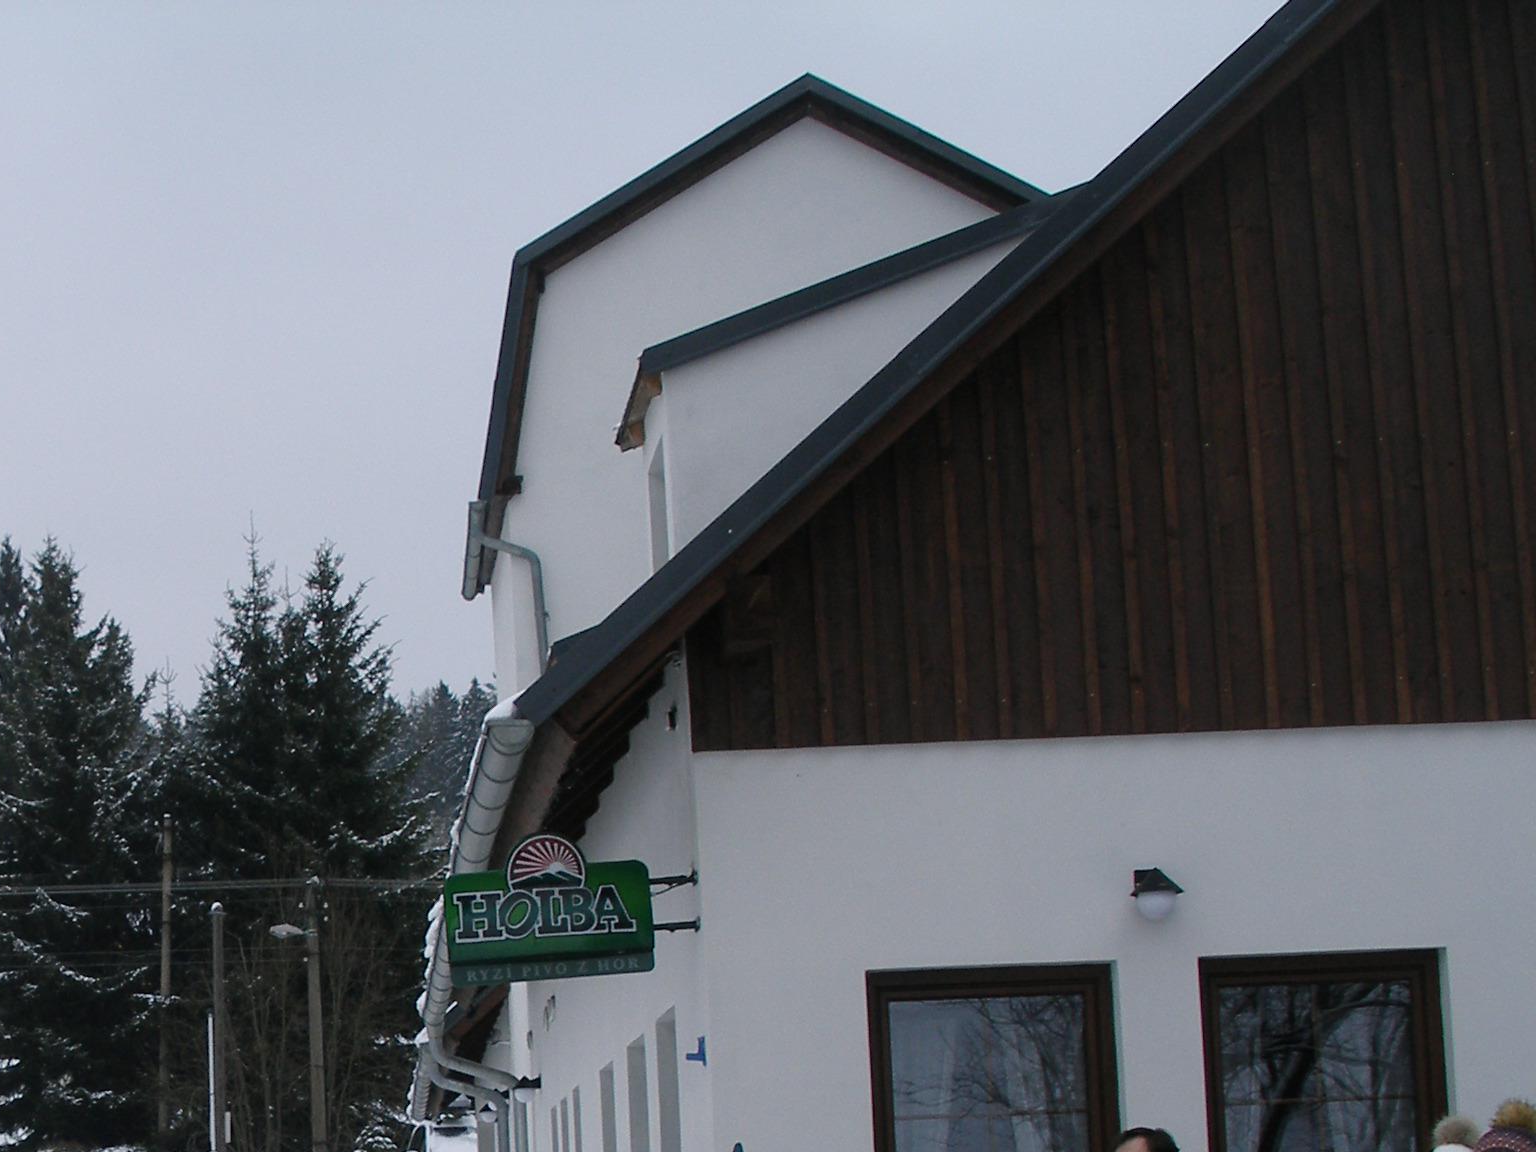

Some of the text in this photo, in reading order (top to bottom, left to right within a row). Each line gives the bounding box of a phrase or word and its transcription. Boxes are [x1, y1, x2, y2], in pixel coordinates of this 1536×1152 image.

[454, 884, 636, 944] HOLBA
[522, 962, 567, 977] PIVO
[578, 961, 588, 973] Z
[598, 957, 640, 971] HOR
